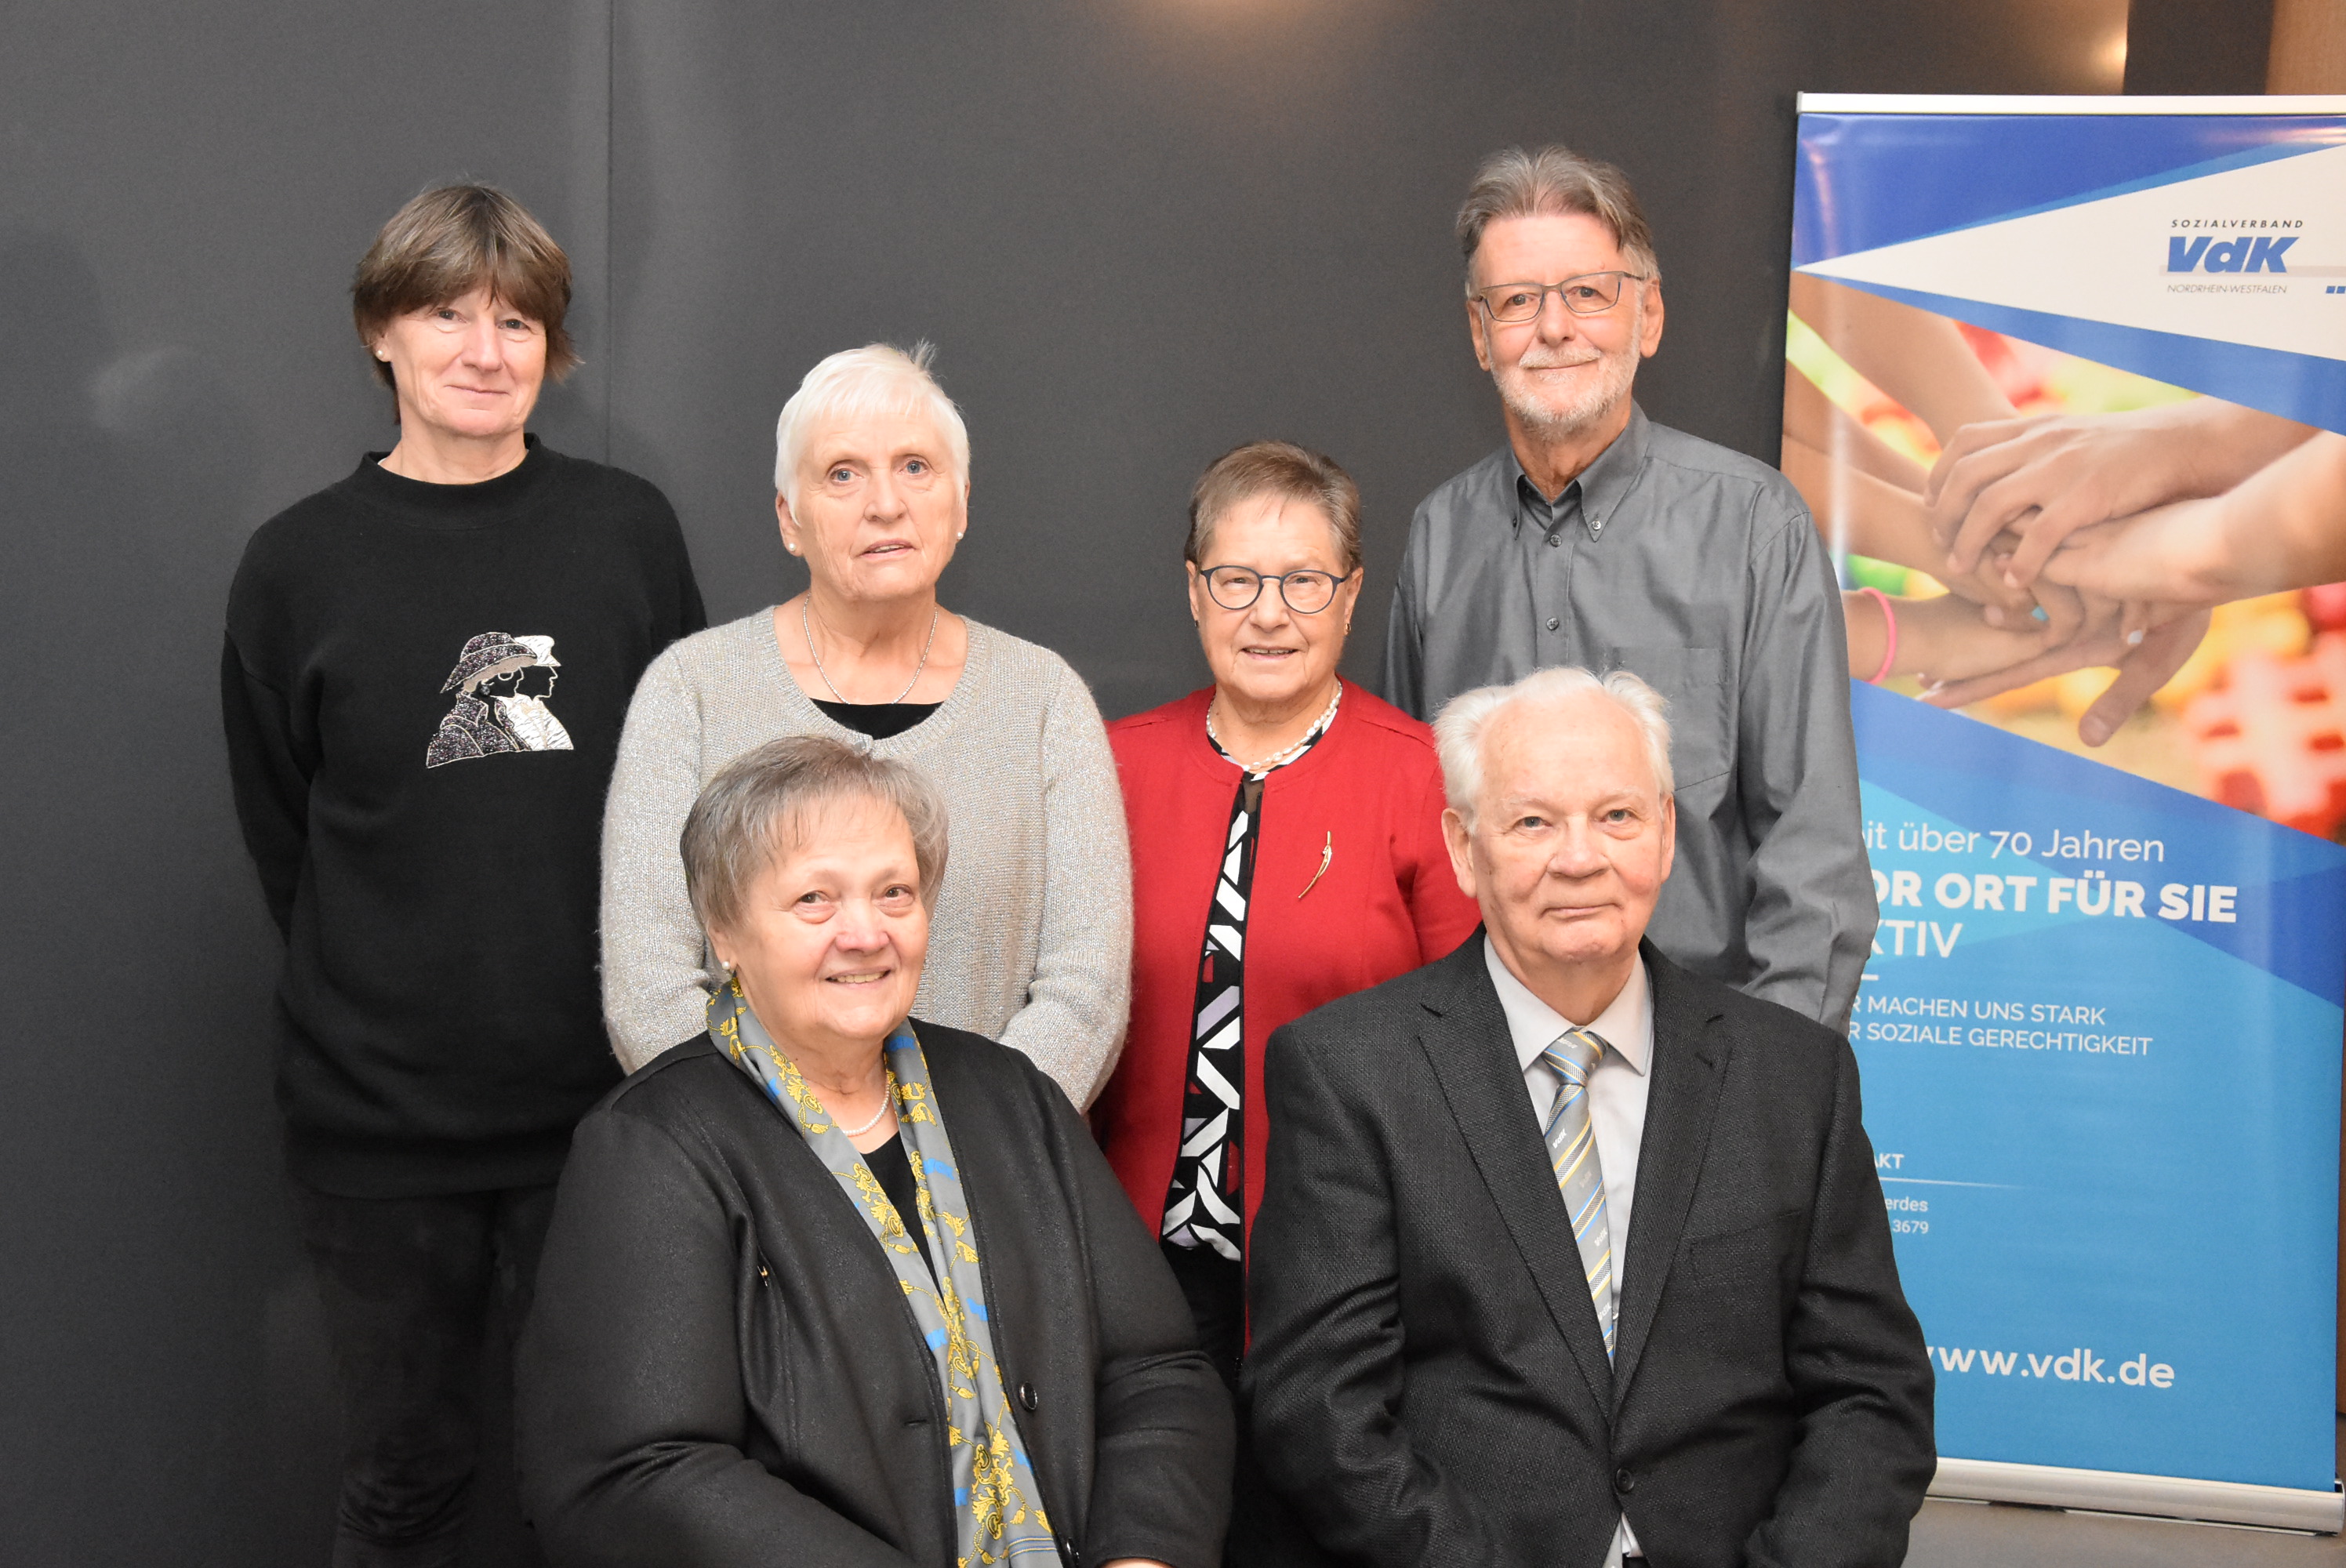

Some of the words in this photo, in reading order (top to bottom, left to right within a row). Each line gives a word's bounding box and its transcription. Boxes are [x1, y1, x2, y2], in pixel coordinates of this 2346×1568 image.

[2171, 219, 2304, 228] SOZIALVERBAND
[2166, 236, 2301, 273] VdK
[2166, 284, 2288, 295] NORDRHEIN-WESTFALEN
[1862, 820, 1888, 850] it
[1898, 822, 1981, 853] über
[1989, 830, 2033, 859] 70
[2041, 828, 2165, 862] Jahren
[1934, 872, 2038, 912] ORT
[2047, 869, 2146, 918] FÜR
[2158, 883, 2238, 924] SIE
[1868, 995, 1969, 1018] MACHEN
[1974, 1000, 2025, 1022] UNS
[2030, 1004, 2107, 1026] STARK
[1866, 1022, 1963, 1045] SOZIALE
[1968, 1027, 2154, 1056] GERECHTIGKEIT
[1552, 1127, 1567, 1149] VdK
[1884, 1196, 1929, 1213] erdes
[1892, 1218, 1930, 1235] 3679
[1926, 1345, 2176, 1388] ww.vdk.de
